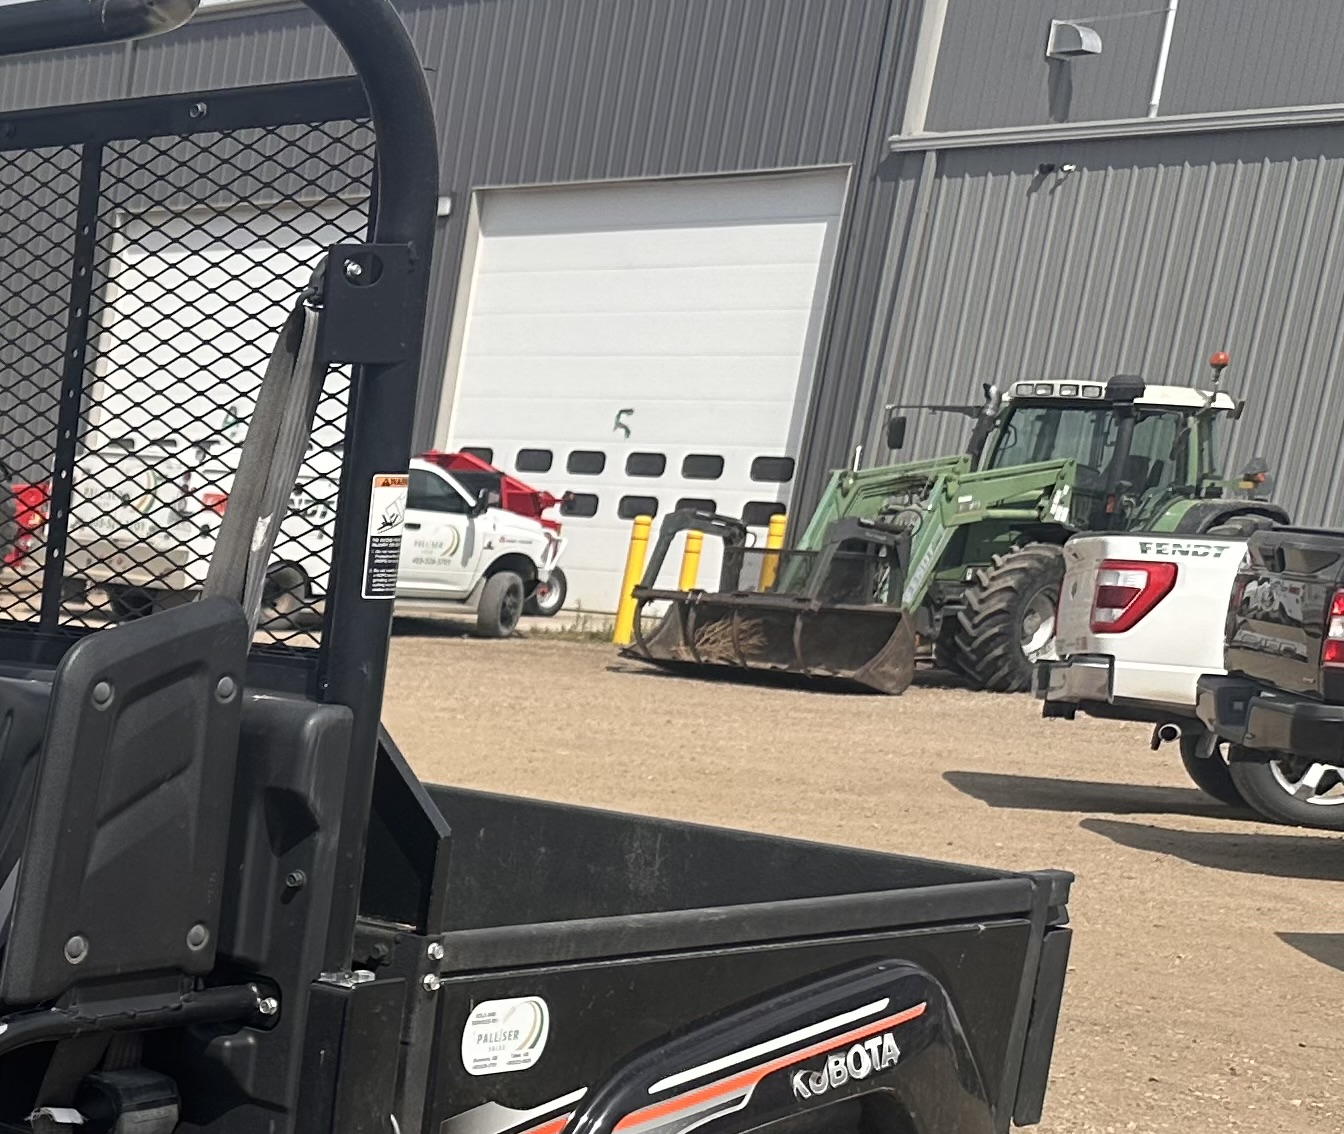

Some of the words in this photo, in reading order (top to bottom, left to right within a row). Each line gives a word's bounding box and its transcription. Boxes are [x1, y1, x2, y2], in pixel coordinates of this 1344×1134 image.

[612, 408, 634, 440] 5
[1138, 541, 1231, 558] FENDT
[790, 1032, 901, 1102] KUBOTA
